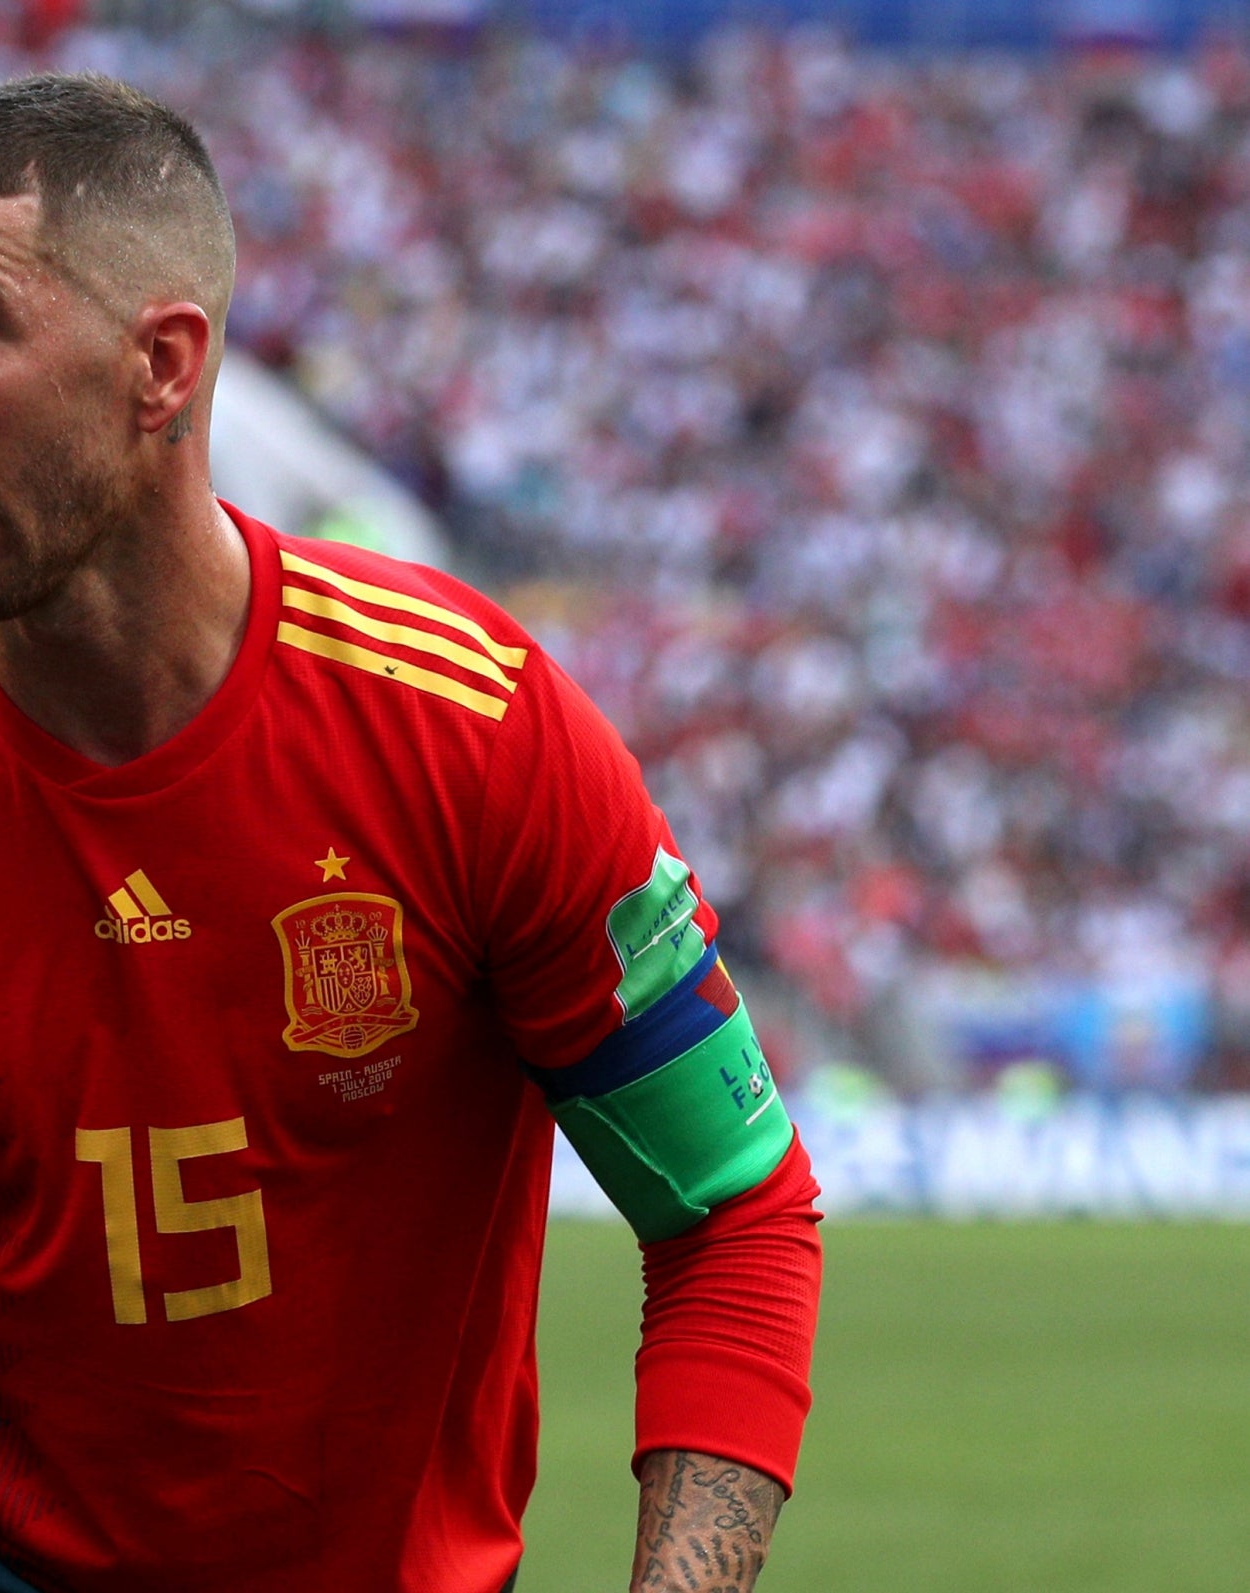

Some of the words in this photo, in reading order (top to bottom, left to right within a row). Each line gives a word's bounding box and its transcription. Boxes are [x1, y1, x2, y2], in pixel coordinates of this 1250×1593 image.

[94, 915, 192, 944] adidas
[318, 1069, 352, 1085] SPAIN
[364, 1055, 402, 1076] RUSSIA
[332, 1083, 338, 1094] 1
[340, 1077, 366, 1093] JULY
[368, 1069, 393, 1085] 2018
[342, 1081, 385, 1103] MOSCOW
[75, 1116, 272, 1324] 15
